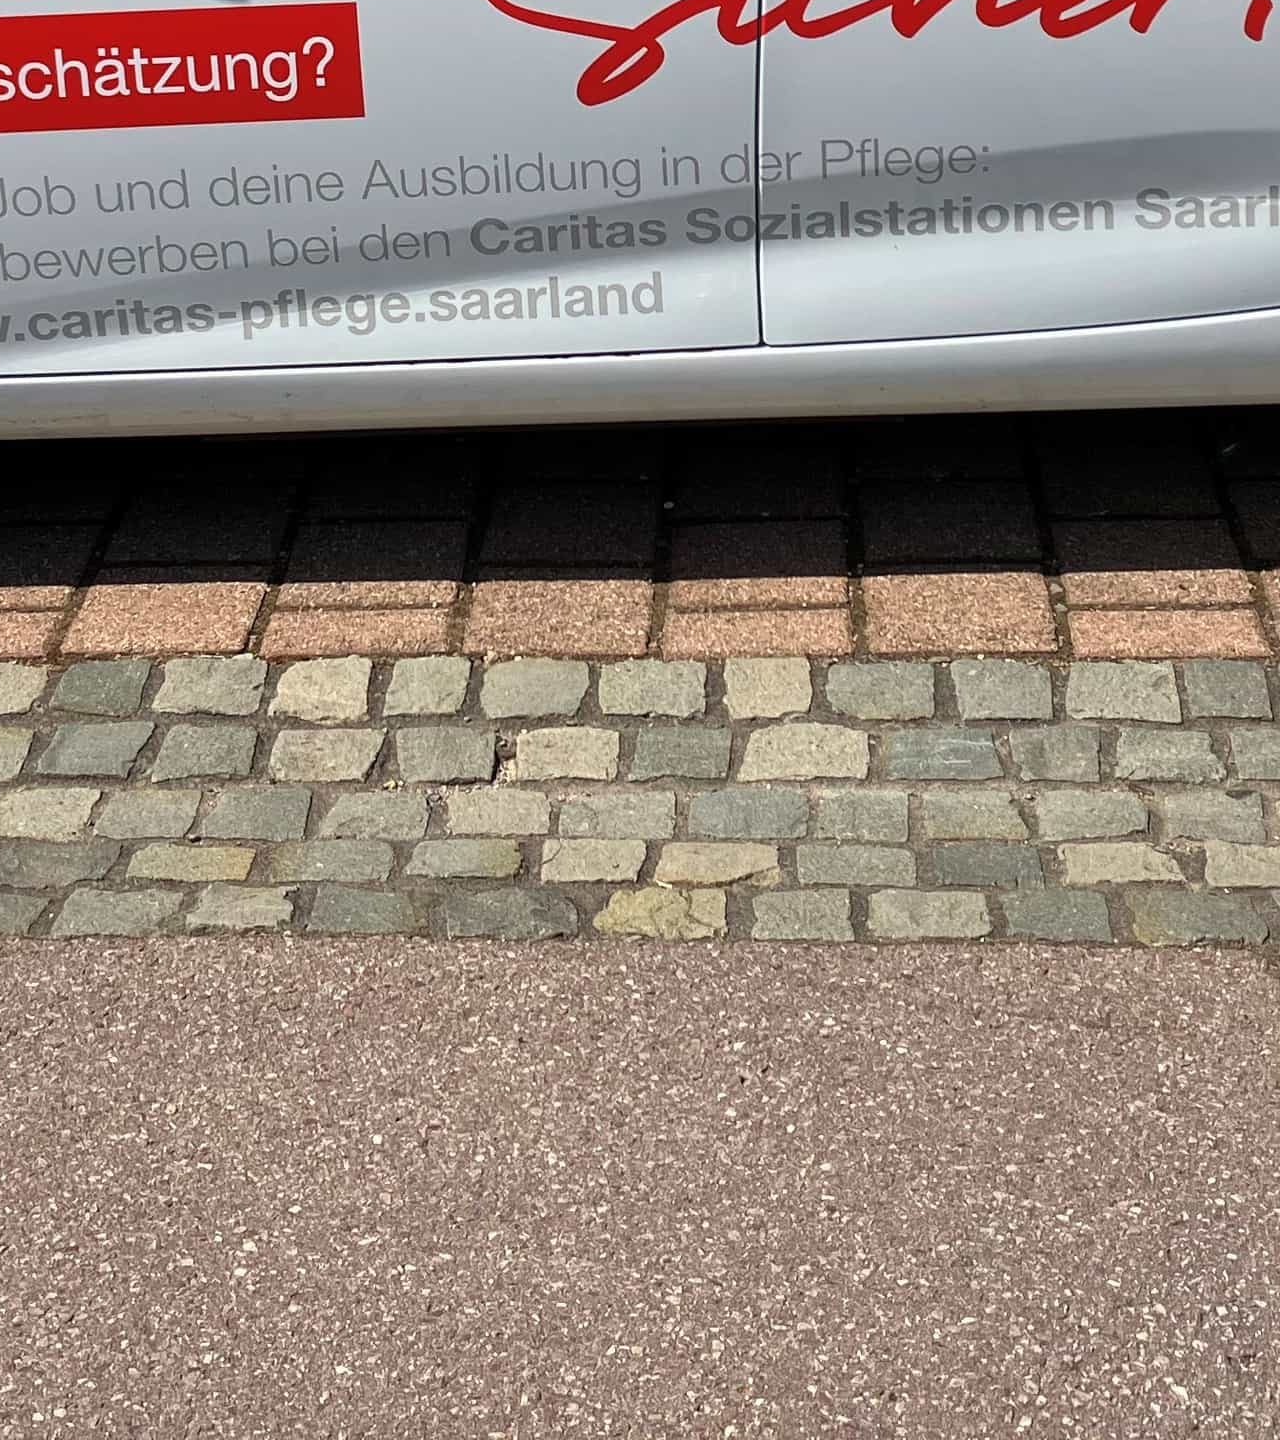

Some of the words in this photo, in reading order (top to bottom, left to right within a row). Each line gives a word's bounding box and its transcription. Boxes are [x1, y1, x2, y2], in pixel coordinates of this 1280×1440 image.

[95, 169, 189, 213] und
[209, 163, 345, 207] deine
[361, 151, 641, 202] Ausbildung
[661, 146, 698, 187] in
[720, 140, 803, 184] der
[821, 138, 990, 189] Pflege:
[0, 234, 247, 282] bewerben
[267, 226, 340, 268] bei
[359, 223, 451, 263] den
[470, 214, 667, 256] Caritas
[686, 193, 1115, 243] Sozialstationen
